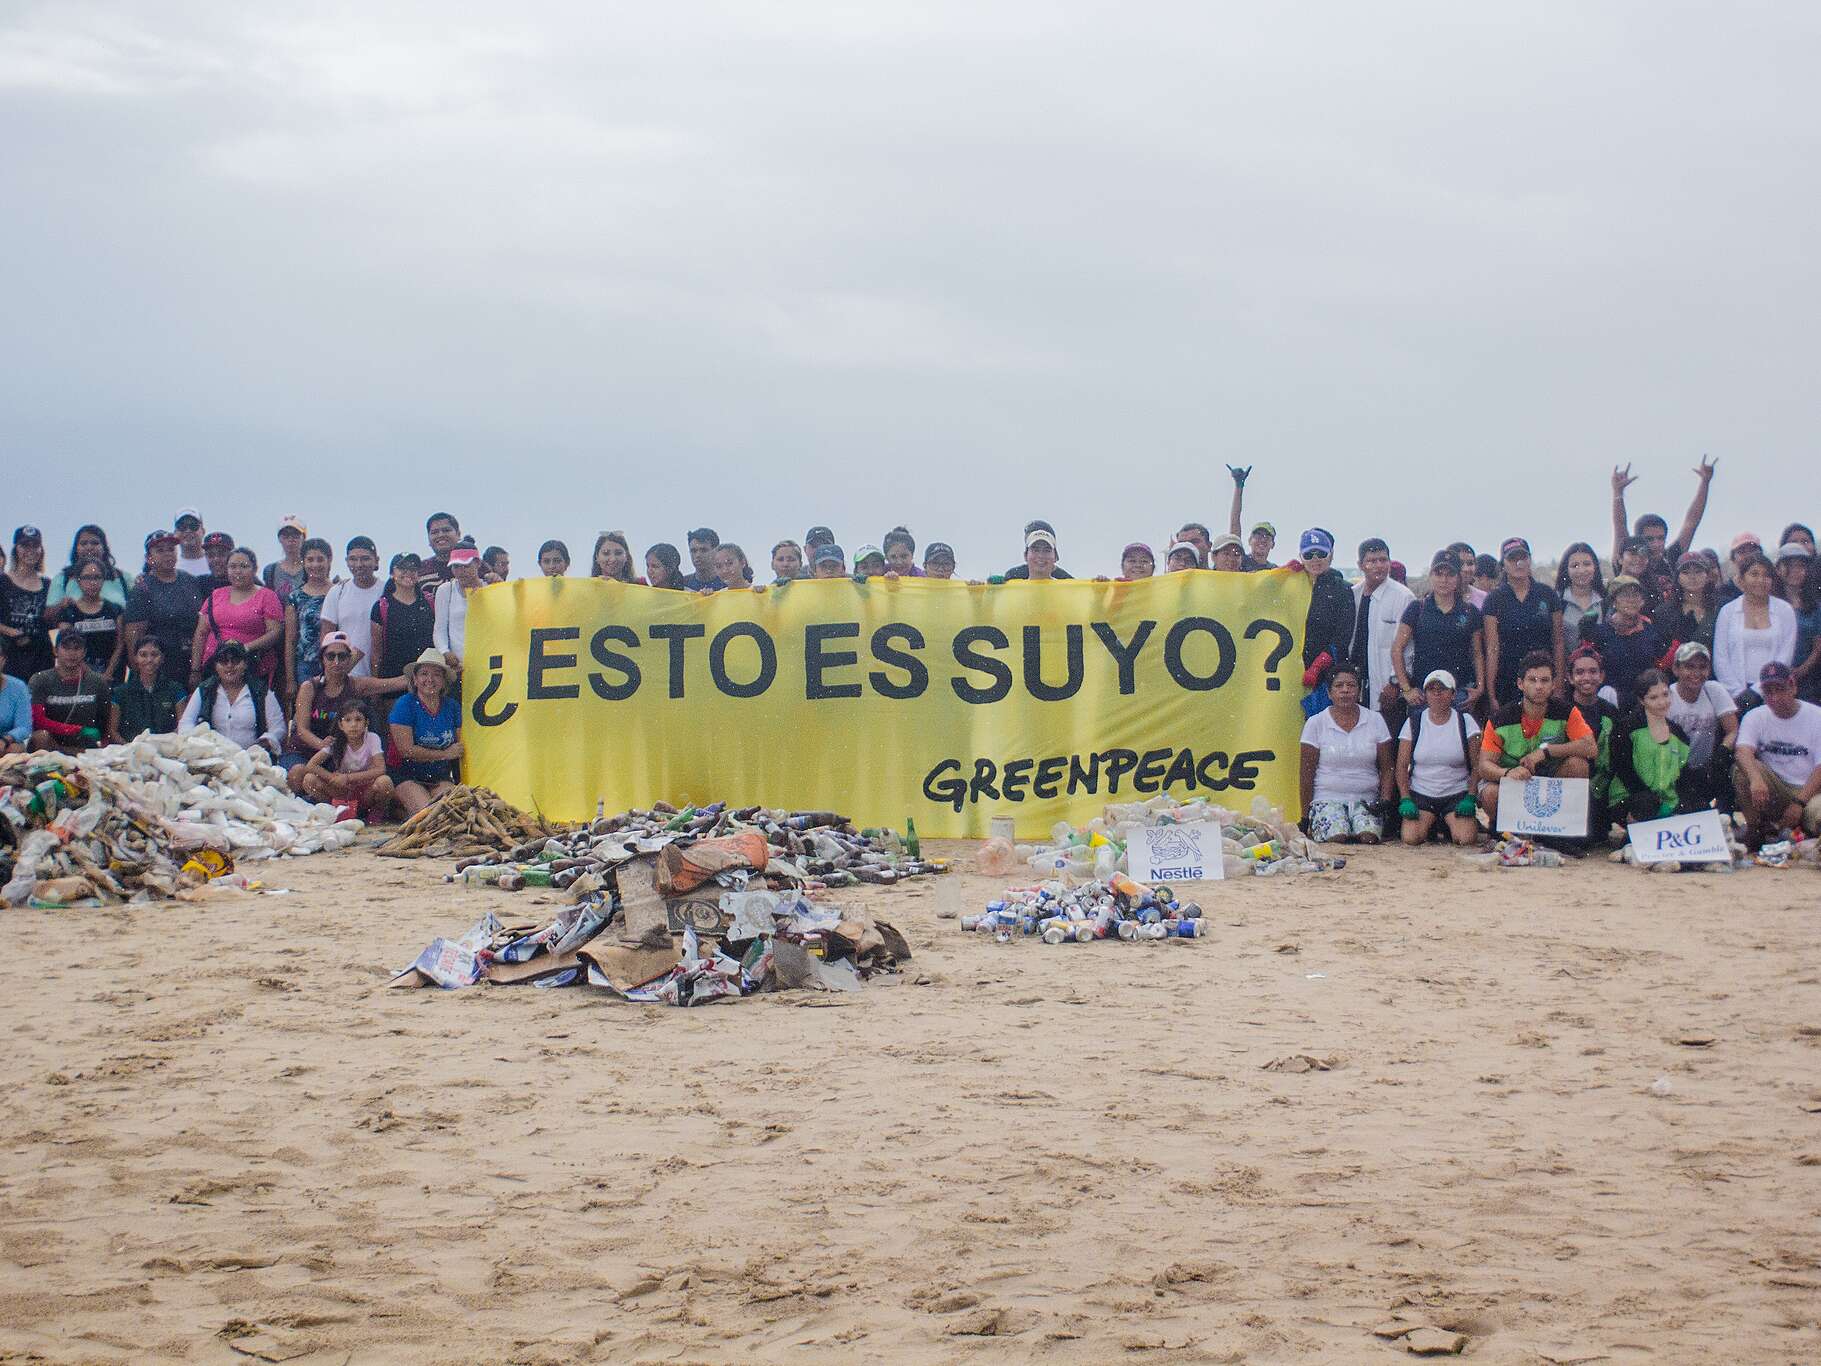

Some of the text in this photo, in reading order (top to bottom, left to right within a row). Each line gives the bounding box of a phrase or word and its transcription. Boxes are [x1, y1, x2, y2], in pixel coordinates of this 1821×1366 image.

[472, 616, 1294, 727] ¿ESTO ES SUYO?
[922, 747, 1276, 813] GREENPEACE
[1516, 821, 1567, 833] Unilever
[1656, 824, 1702, 850] P&G
